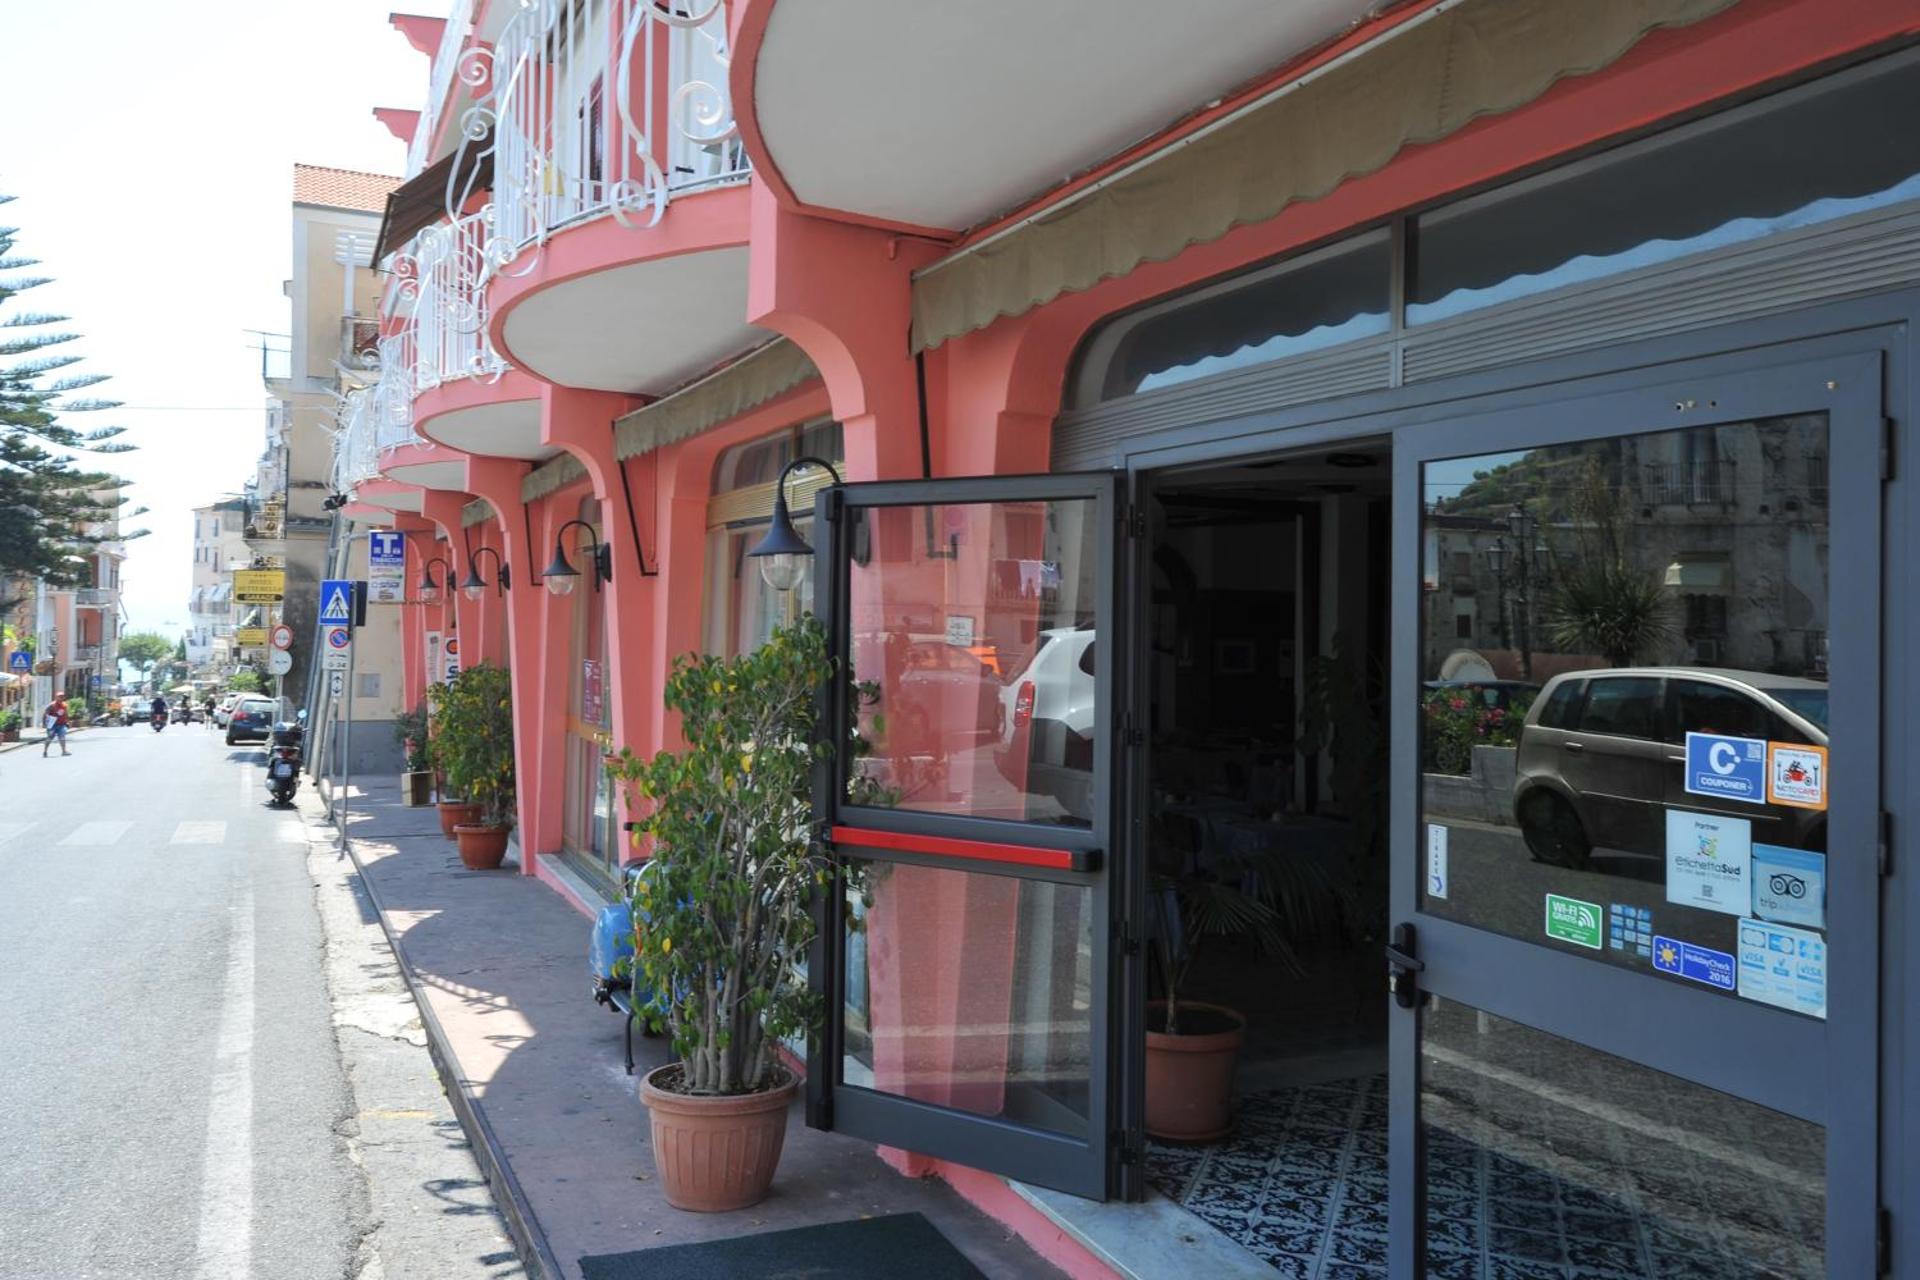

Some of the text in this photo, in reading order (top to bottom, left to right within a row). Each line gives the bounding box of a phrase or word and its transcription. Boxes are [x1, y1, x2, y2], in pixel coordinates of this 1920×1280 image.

[376, 534, 398, 554] T
[1700, 776, 1747, 791] COUPONER
[1695, 821, 1720, 831] Partner
[1684, 952, 1731, 971] HolidayCheck
[1744, 951, 1765, 962] VISA
[1709, 971, 1731, 985] 2016
[1801, 965, 1822, 977] VISA
